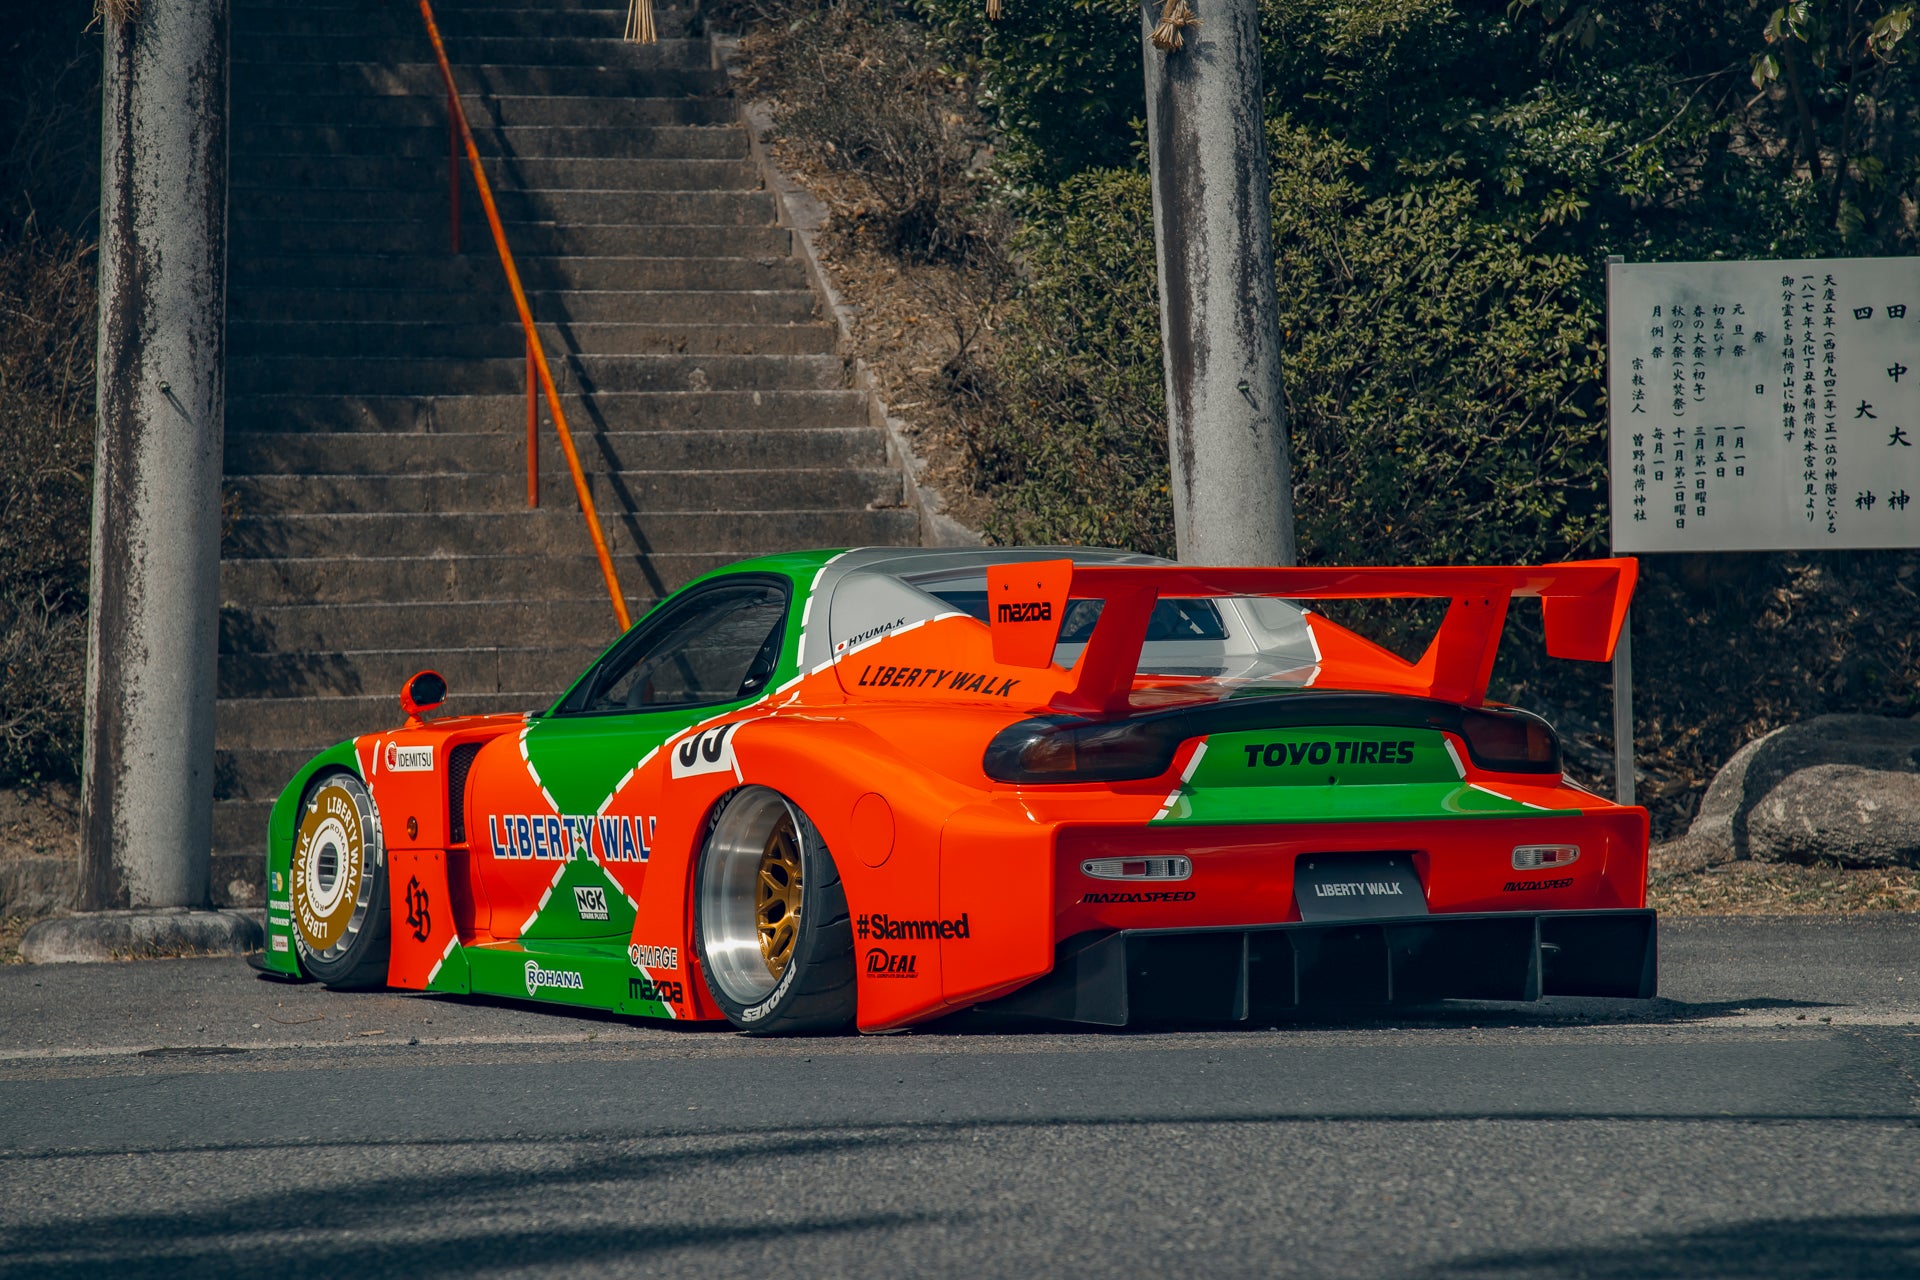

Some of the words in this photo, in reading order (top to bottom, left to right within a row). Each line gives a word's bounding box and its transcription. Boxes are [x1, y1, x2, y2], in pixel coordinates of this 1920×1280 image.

[1651, 305, 1664, 358] 月例祭
[1732, 304, 1746, 357] 元旦祭
[1632, 358, 1646, 413] 宗教法人
[1753, 331, 1766, 394] 祭日
[1853, 306, 1877, 510] 四大神
[1887, 304, 1912, 511] 田中大神
[1652, 427, 1665, 481] 毎月一日
[1694, 426, 1706, 516] 三月第一日曜日
[1714, 427, 1726, 477] 一月五日
[1733, 426, 1746, 476] 一月一日
[1673, 427, 1686, 529] 十一月第二日曜日
[848, 617, 905, 647] HYUMA.K
[858, 665, 951, 688] LIBERTY
[948, 671, 1021, 698] WALK
[397, 752, 432, 767] IDEMITSU
[1244, 741, 1331, 768] TOYO
[1334, 741, 1415, 765] TIRES
[327, 796, 358, 843] LIBERTY
[344, 846, 359, 904] WALK
[489, 815, 597, 861] LIBERTY
[575, 890, 606, 911] NGK
[1083, 891, 1196, 904] MAZDASPEED
[1315, 884, 1364, 897] LIBERTY
[1367, 882, 1403, 895] WALK
[857, 913, 970, 940] #Slammed
[528, 970, 582, 987] ROHANA
[631, 945, 678, 969] CHARGE
